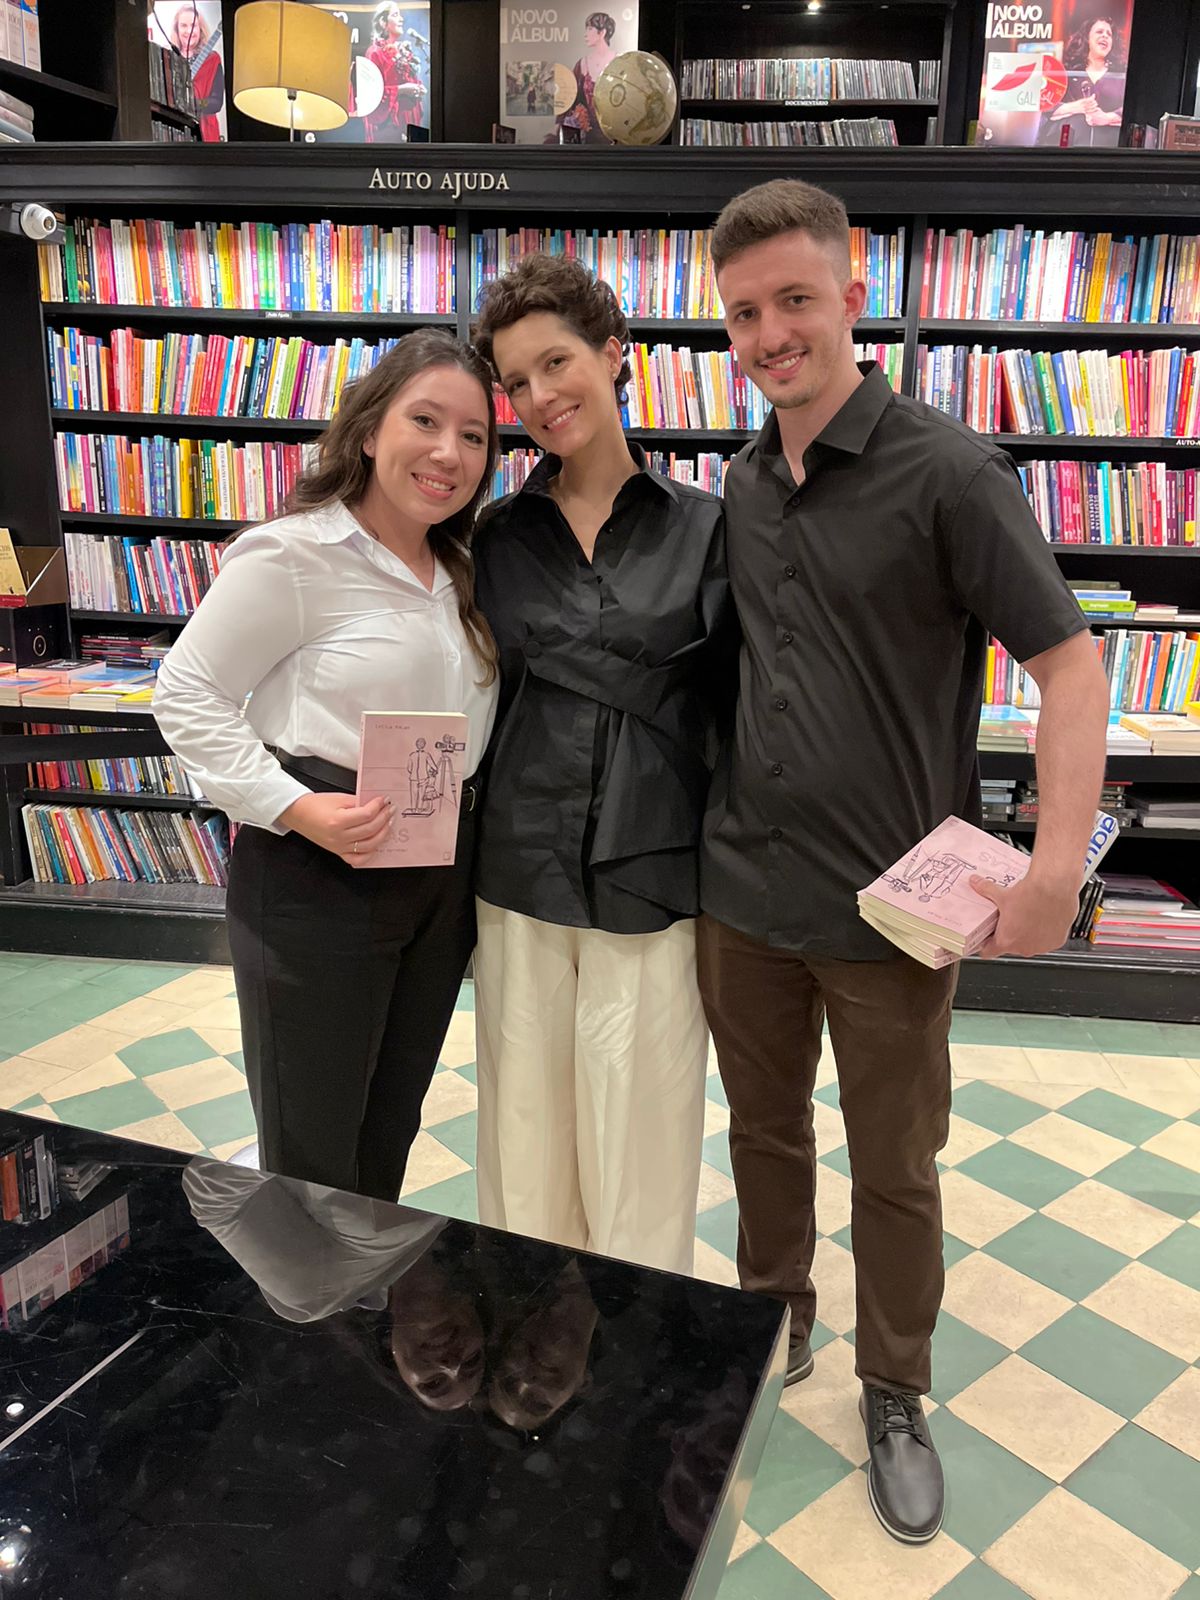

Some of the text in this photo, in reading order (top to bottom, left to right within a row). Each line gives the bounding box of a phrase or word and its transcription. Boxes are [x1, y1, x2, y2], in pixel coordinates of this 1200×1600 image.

[510, 8, 558, 26] NOVO
[992, 4, 1042, 22] NOVO
[510, 25, 569, 43] ÁLBUM
[991, 19, 1053, 40] ÁLBUM
[368, 167, 432, 191] AUTO
